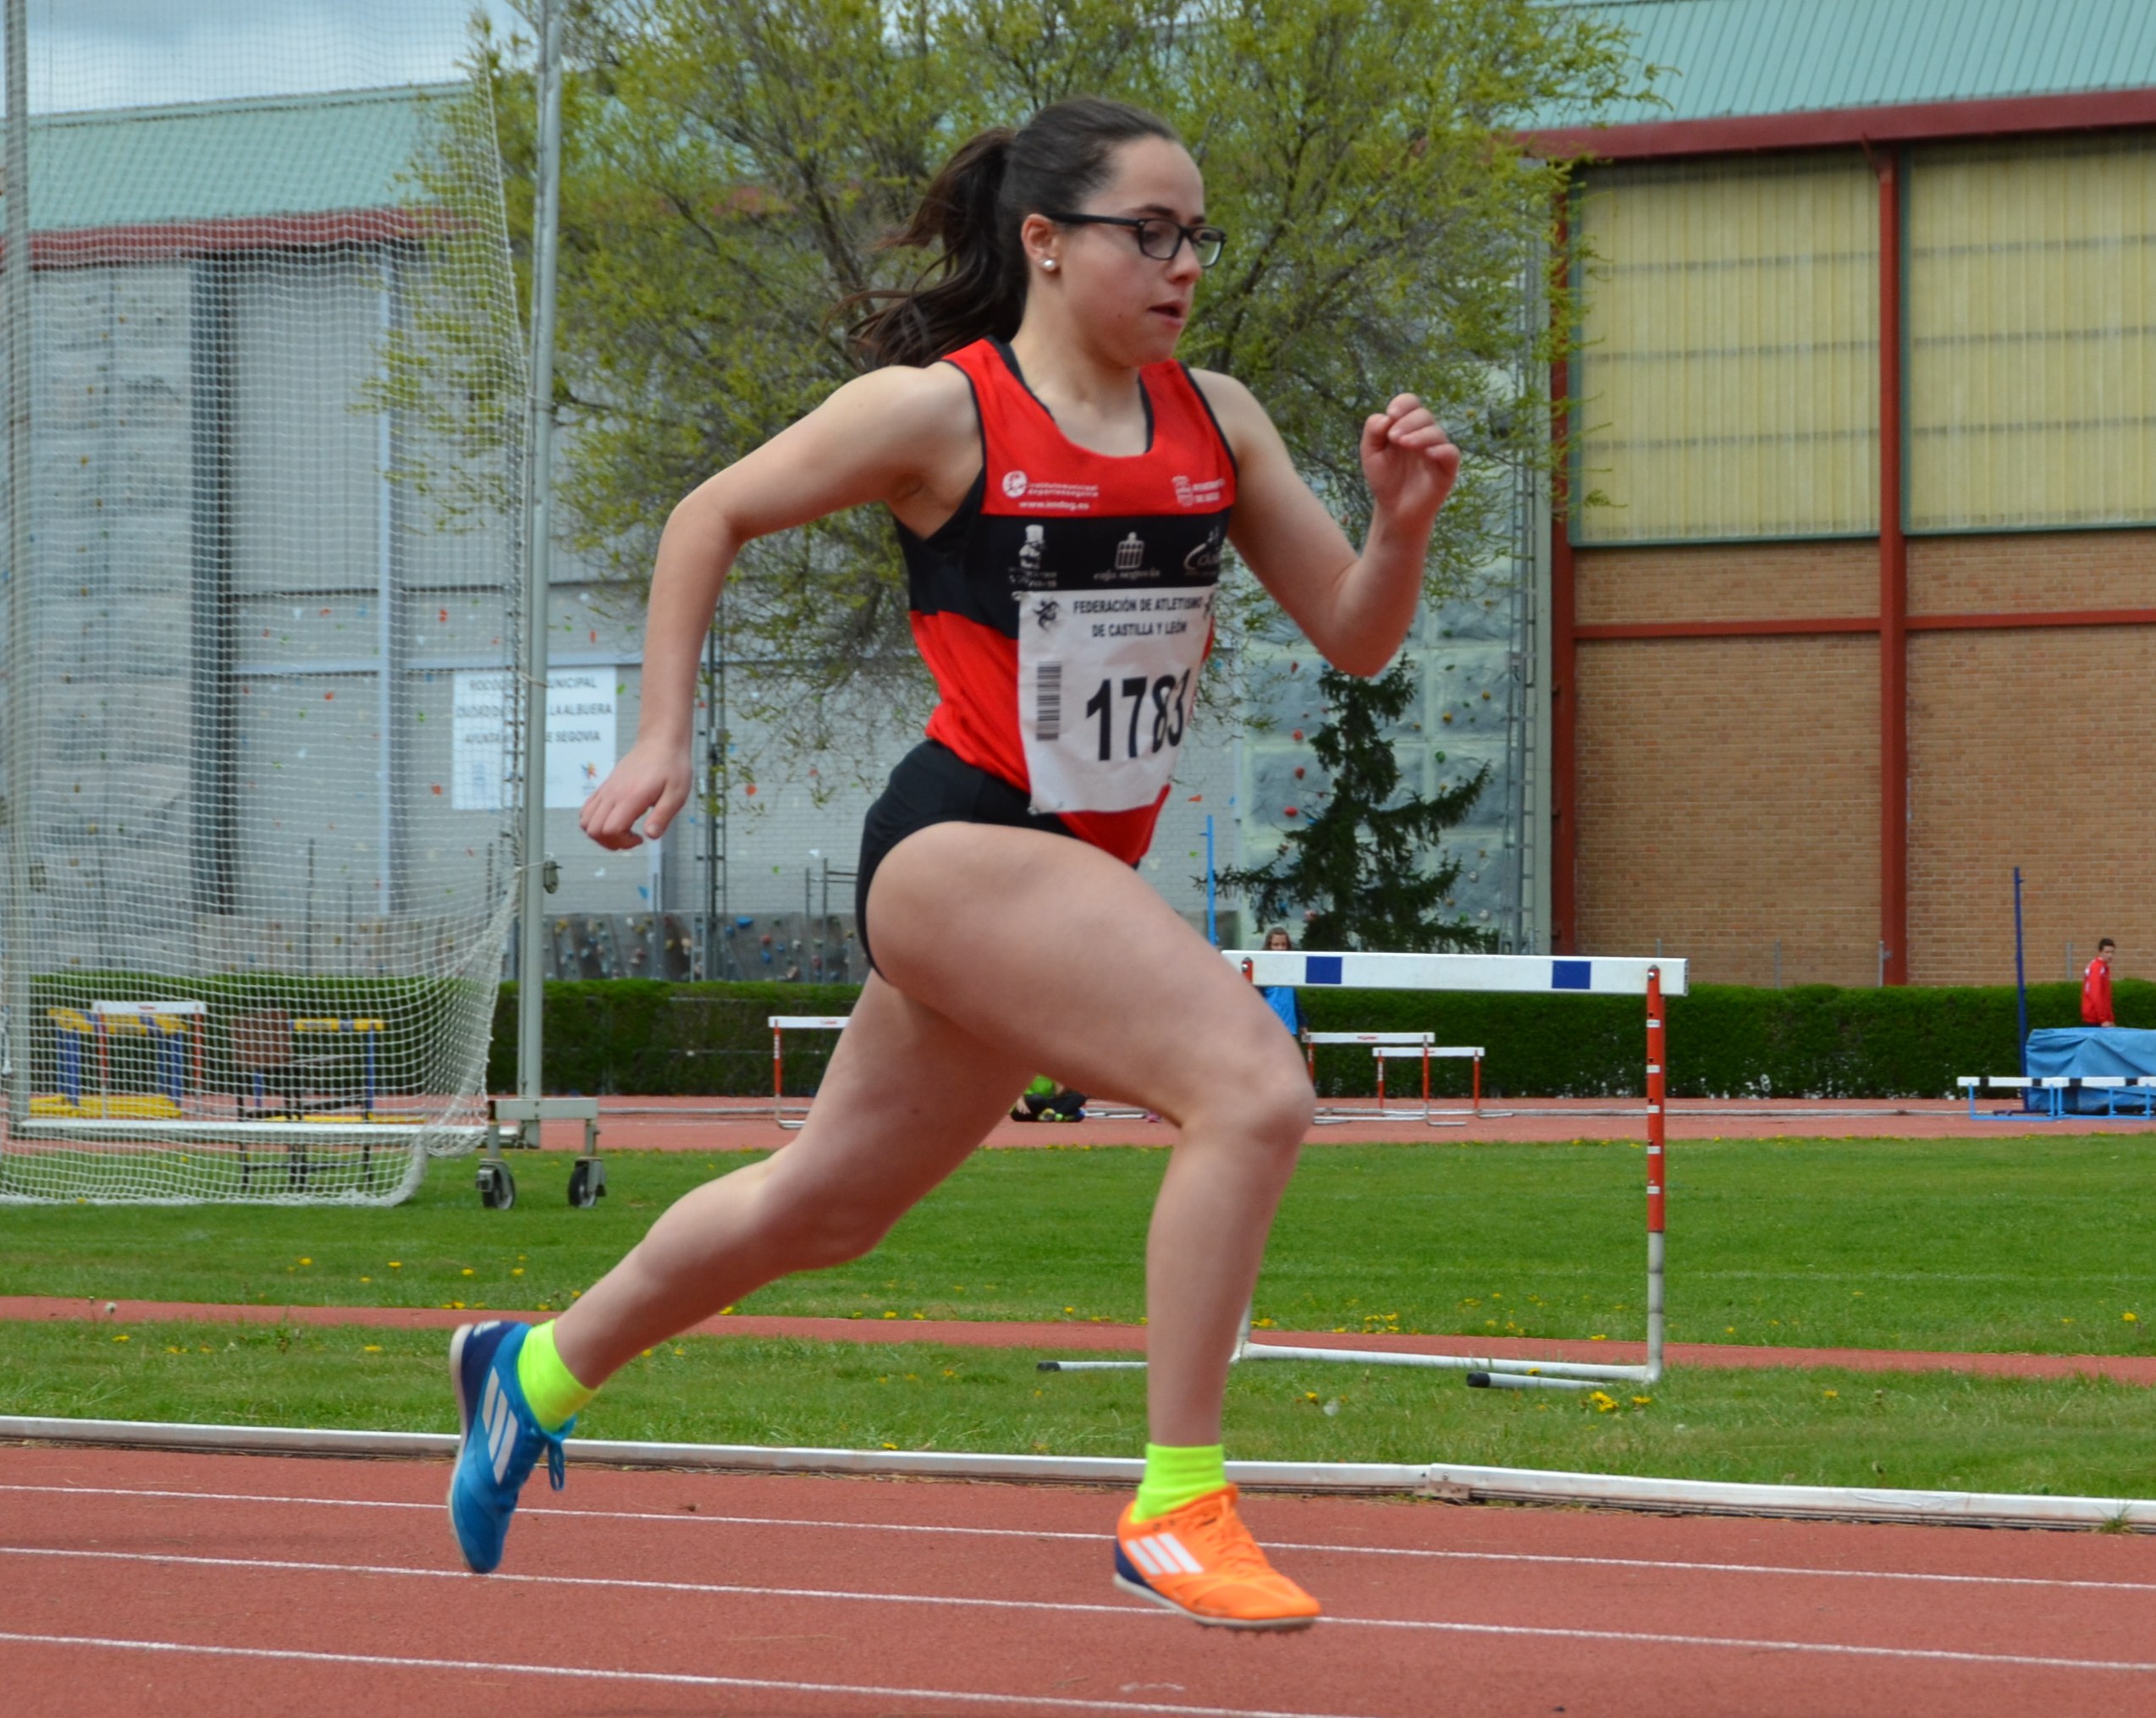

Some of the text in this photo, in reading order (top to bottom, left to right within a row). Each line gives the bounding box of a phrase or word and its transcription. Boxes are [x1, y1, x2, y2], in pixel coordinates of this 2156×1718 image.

[1073, 596, 1136, 614] FEDERACIÓN
[1139, 599, 1153, 611] DE
[1092, 623, 1106, 637] DE
[1108, 621, 1153, 636] CASTILLA
[1156, 621, 1164, 635] Y
[546, 677, 597, 688] UNICIPAL
[556, 730, 600, 742] SEGOVIA
